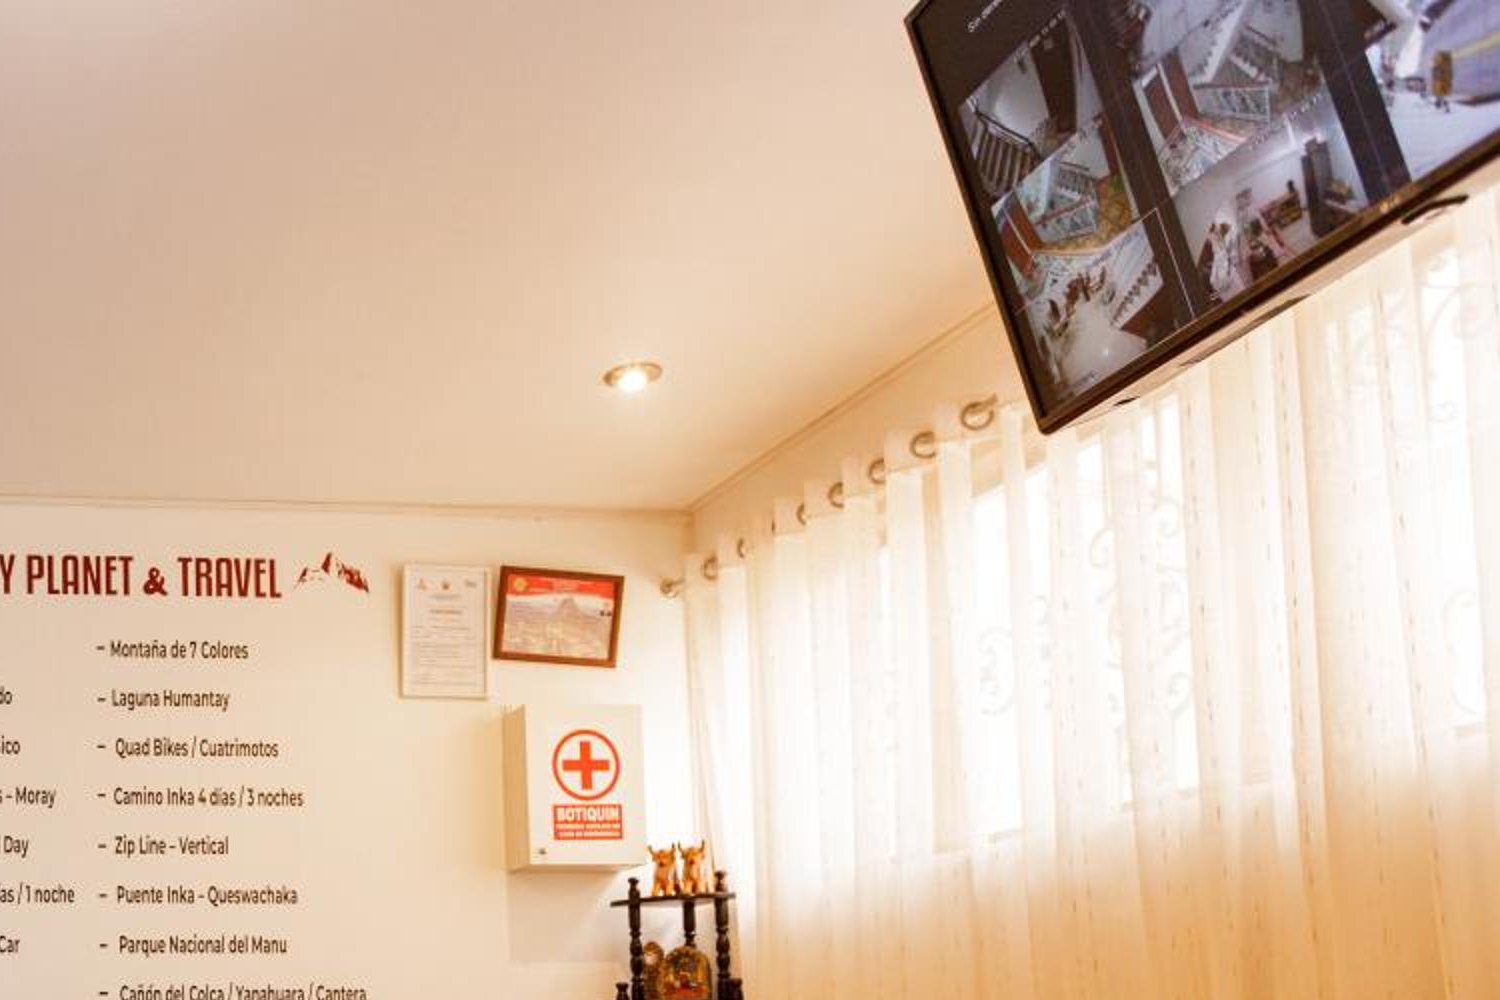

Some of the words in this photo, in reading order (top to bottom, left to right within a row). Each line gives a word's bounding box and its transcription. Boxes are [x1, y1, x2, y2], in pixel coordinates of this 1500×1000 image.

[26, 553, 135, 597] PLANET
[142, 566, 169, 597] &
[176, 556, 282, 599] TRAVEL
[110, 640, 167, 659] Montaña
[170, 640, 187, 659] de
[189, 640, 197, 659] 7
[201, 640, 249, 660] Colores
[111, 689, 161, 711] Laguna
[163, 690, 230, 712] Humantay
[115, 737, 151, 759] Quad
[153, 737, 189, 757] Bikes
[200, 738, 279, 757] Cuatrimotos
[15, 786, 57, 809] Moray
[113, 785, 163, 805] Camino
[167, 786, 195, 805] Inka
[197, 787, 207, 804] 4
[247, 788, 256, 807] 3
[257, 788, 305, 807] noches
[3, 835, 29, 859] Day
[115, 834, 136, 858] Zip
[139, 835, 167, 855] Line
[178, 835, 229, 855] Vertical
[25, 884, 31, 904] 1
[34, 884, 75, 904] noche
[116, 885, 164, 904] Puente
[167, 885, 195, 904] Inka
[207, 885, 298, 907] Queswachaka
[119, 934, 166, 958] Parque
[169, 934, 225, 954] Nacional
[228, 934, 249, 954] del
[251, 935, 288, 954] Manu
